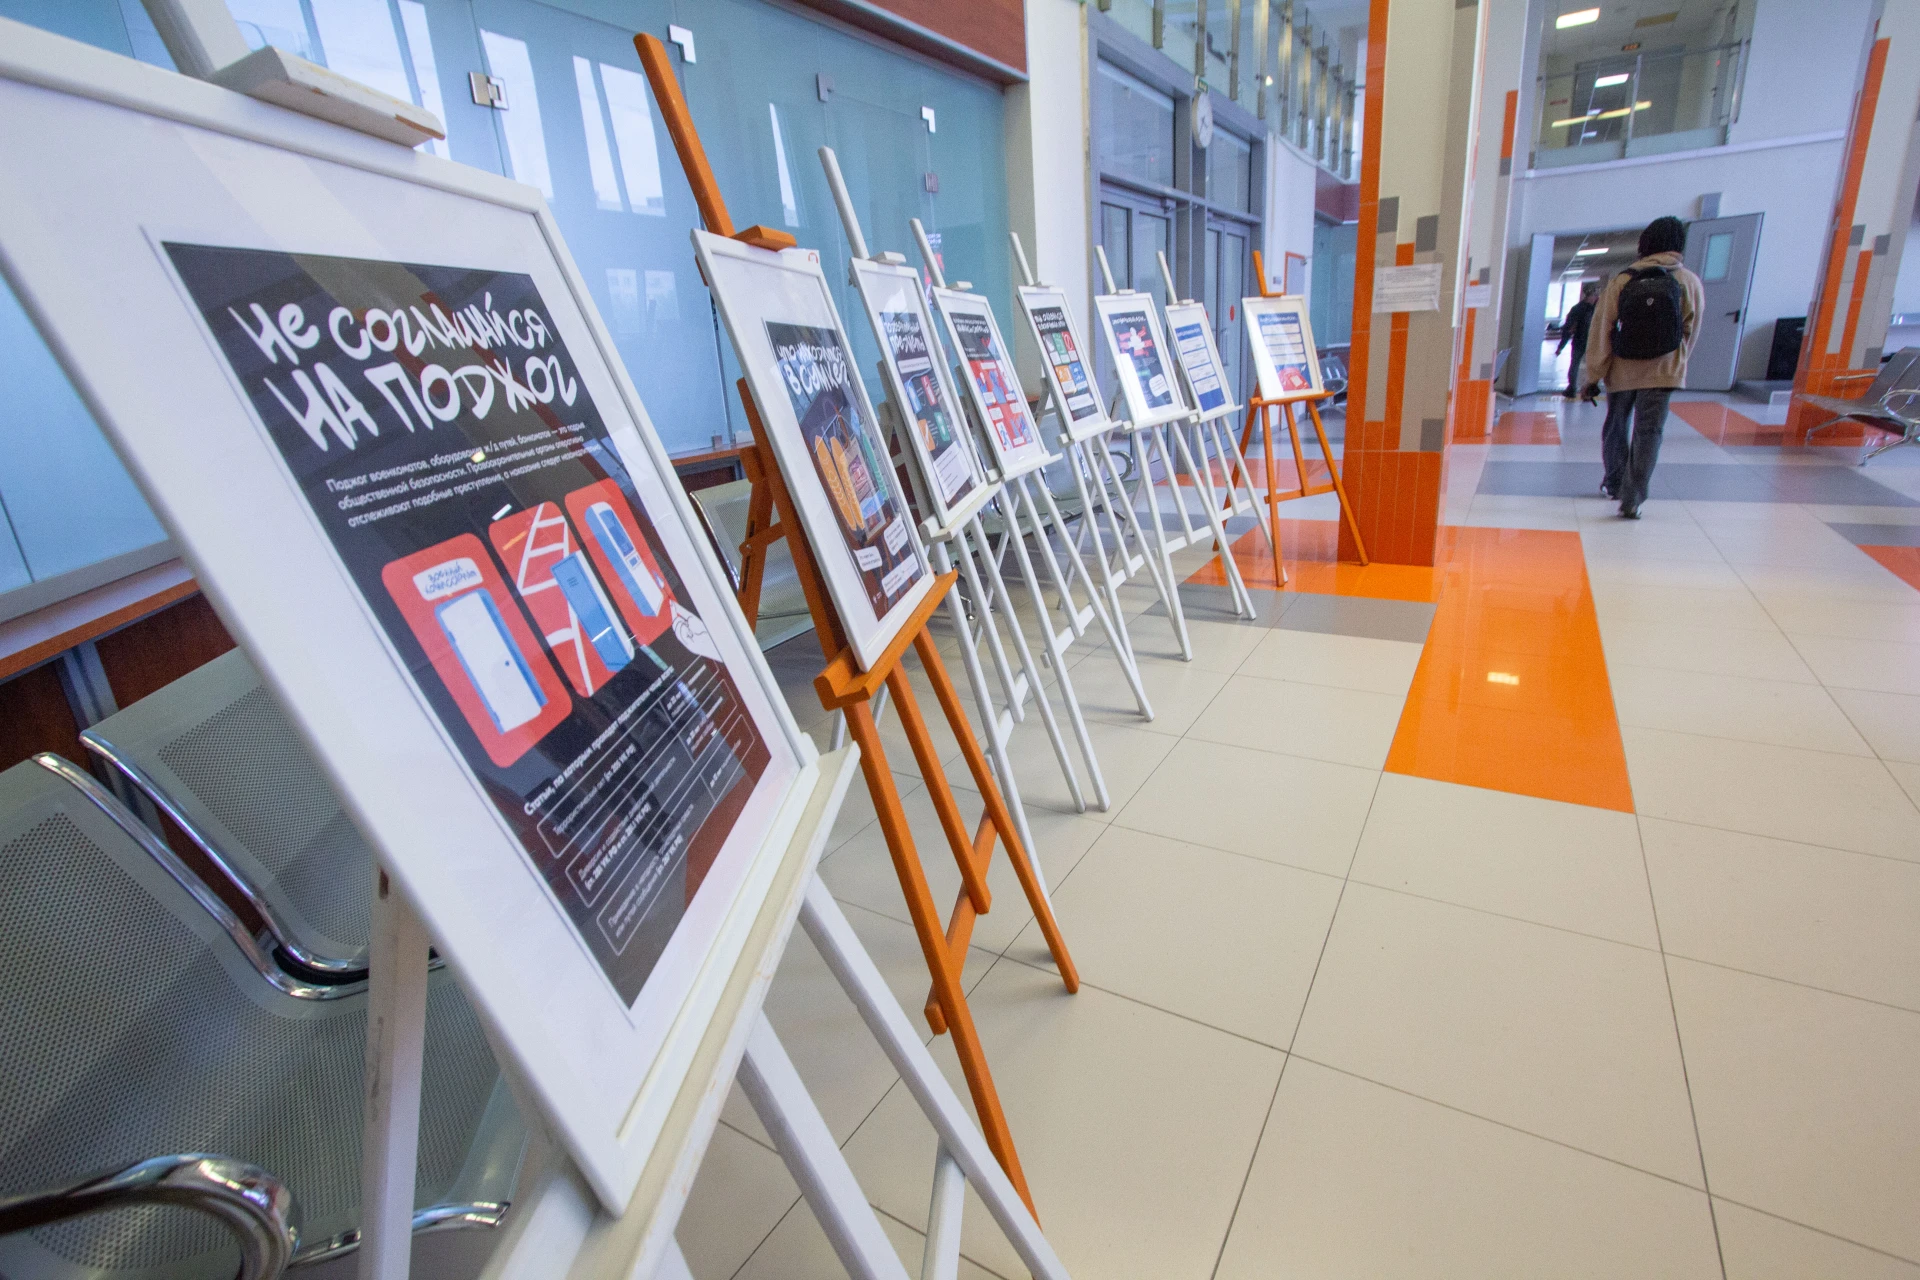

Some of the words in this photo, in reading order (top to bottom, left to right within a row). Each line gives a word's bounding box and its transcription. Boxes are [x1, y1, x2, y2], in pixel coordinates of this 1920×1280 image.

[263, 362, 379, 451] НА
[363, 355, 577, 433] ПОДЖОГ
[325, 474, 367, 492] Поджог
[369, 460, 430, 482] военкоматов,
[430, 446, 483, 467] оборудования
[484, 440, 500, 453] ж/д
[338, 481, 410, 510] общественной
[465, 447, 536, 474] Правоохранительные
[348, 500, 412, 527] отслеживают
[411, 488, 454, 508] подобные
[453, 472, 504, 496] преступления,
[523, 786, 555, 815] Статьи,
[553, 774, 564, 787] по
[562, 747, 592, 778] которым
